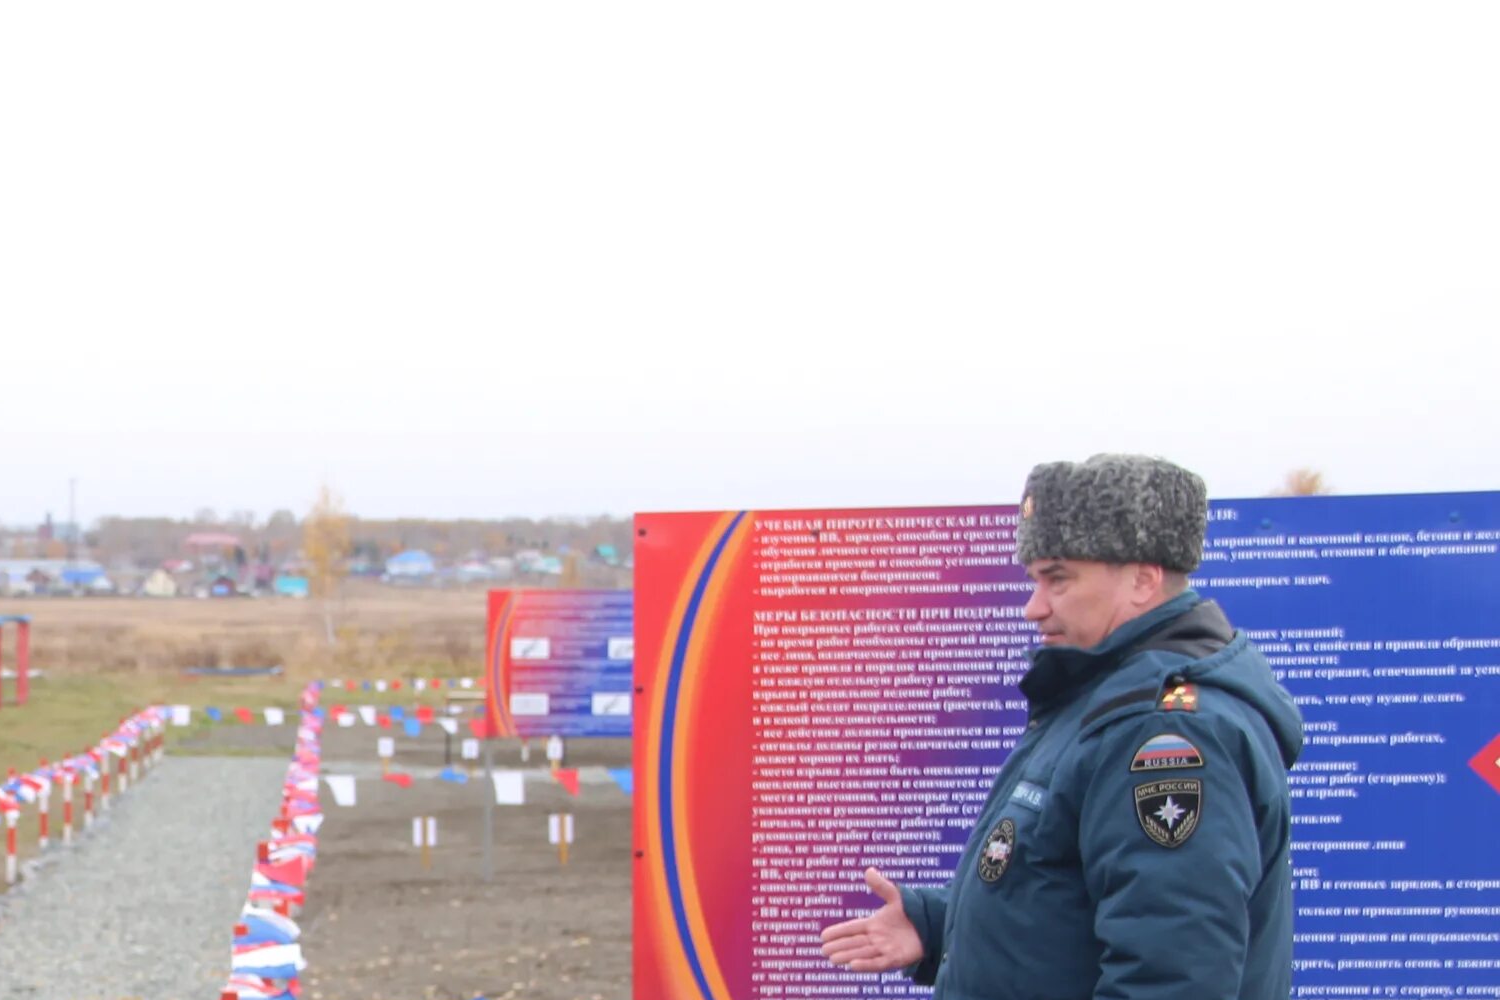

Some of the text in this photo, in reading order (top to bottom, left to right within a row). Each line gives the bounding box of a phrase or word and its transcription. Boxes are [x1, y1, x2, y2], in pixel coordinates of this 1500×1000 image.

[1144, 758, 1188, 768] RUSSIA
[1138, 782, 1197, 797] МЧС РОССИИ
